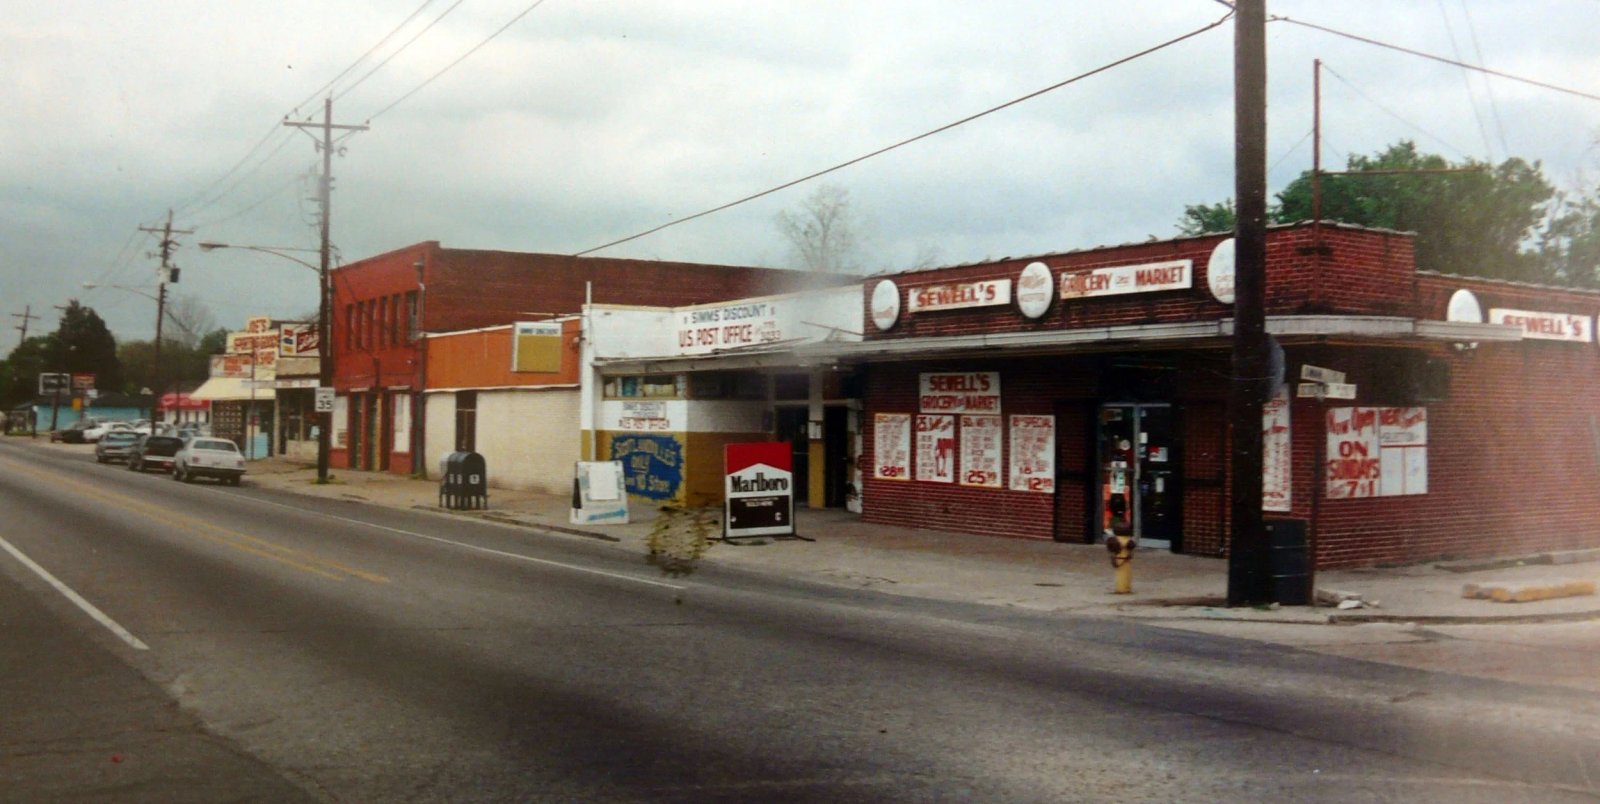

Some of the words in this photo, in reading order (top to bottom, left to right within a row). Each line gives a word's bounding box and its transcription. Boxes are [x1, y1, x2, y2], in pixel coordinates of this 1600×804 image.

[1062, 272, 1113, 294] GROCERY
[1135, 265, 1185, 286] MARKET
[916, 283, 996, 308] SEWELL'S
[723, 304, 767, 321] DISCOUNT
[697, 326, 720, 346] POST
[723, 323, 753, 345] OFFICE
[928, 373, 991, 392] SEWELL'S
[318, 400, 332, 410] 35
[1339, 440, 1368, 457] ON
[731, 472, 789, 493] Marlboro
